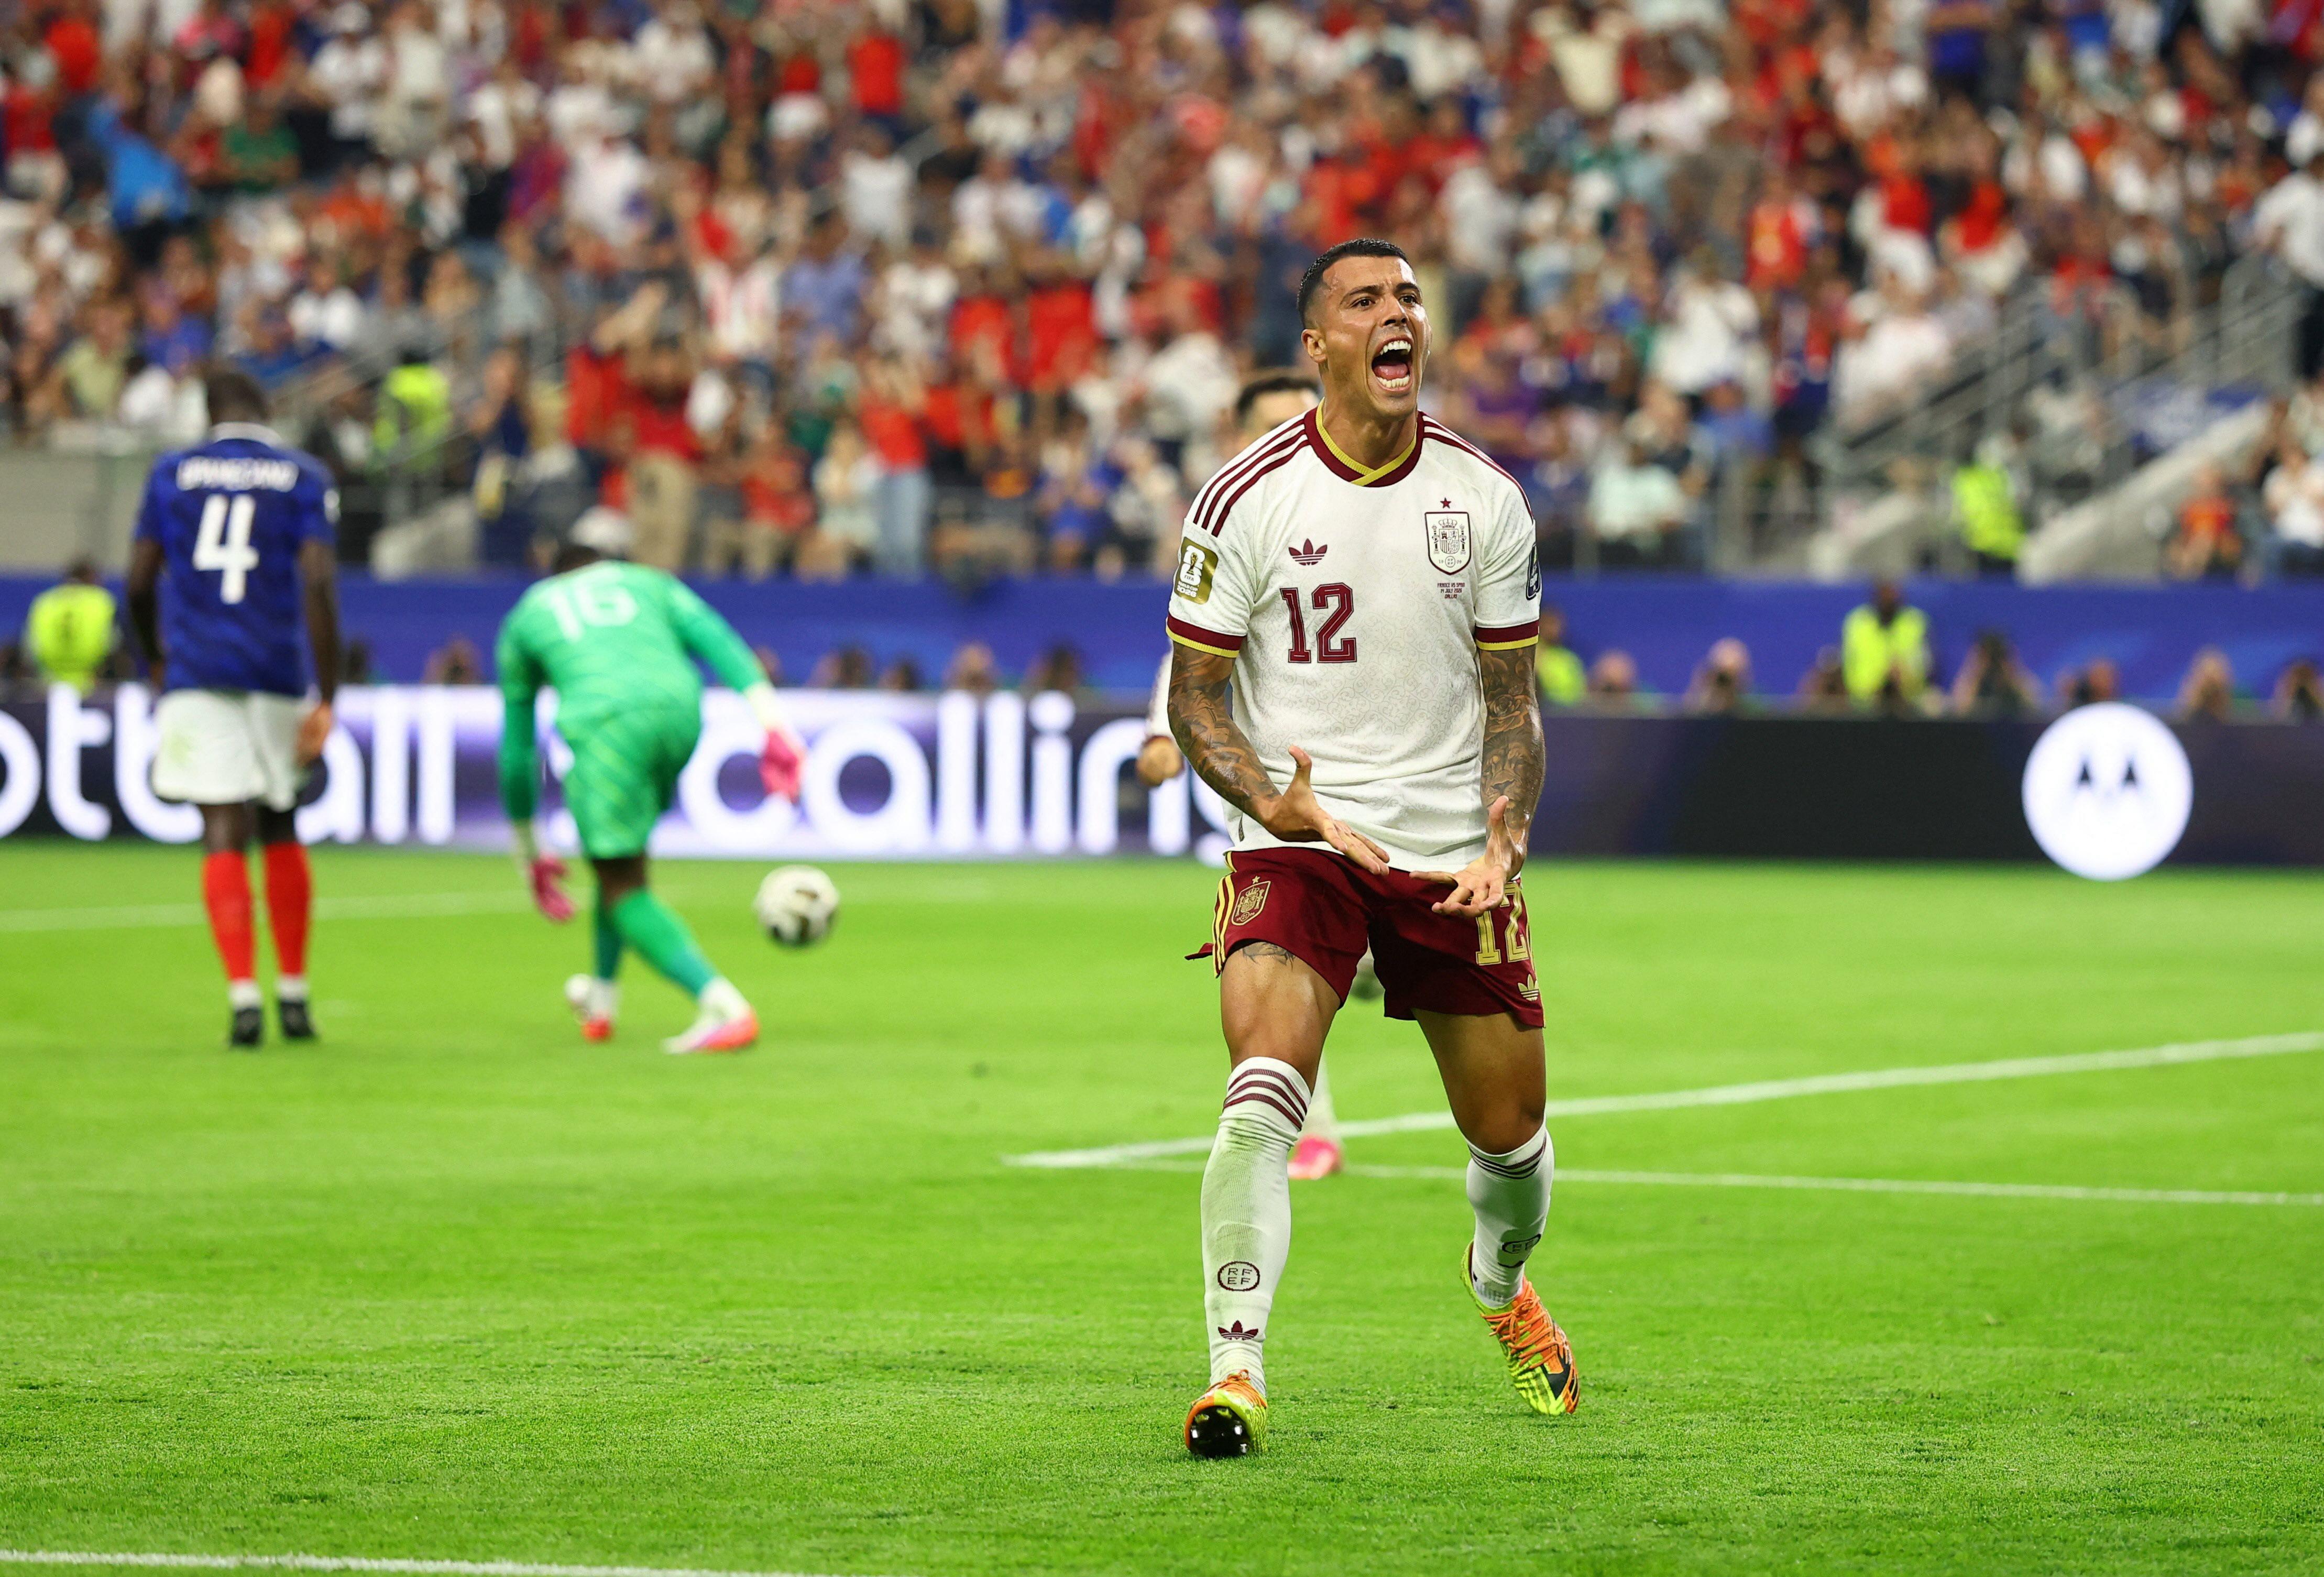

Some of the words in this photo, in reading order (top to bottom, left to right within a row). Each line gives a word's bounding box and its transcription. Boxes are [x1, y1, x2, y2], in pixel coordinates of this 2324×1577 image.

[193, 492, 259, 605] 4
[549, 565, 640, 644] 16
[1279, 582, 1357, 663] 12
[1468, 881, 1530, 966] 12
